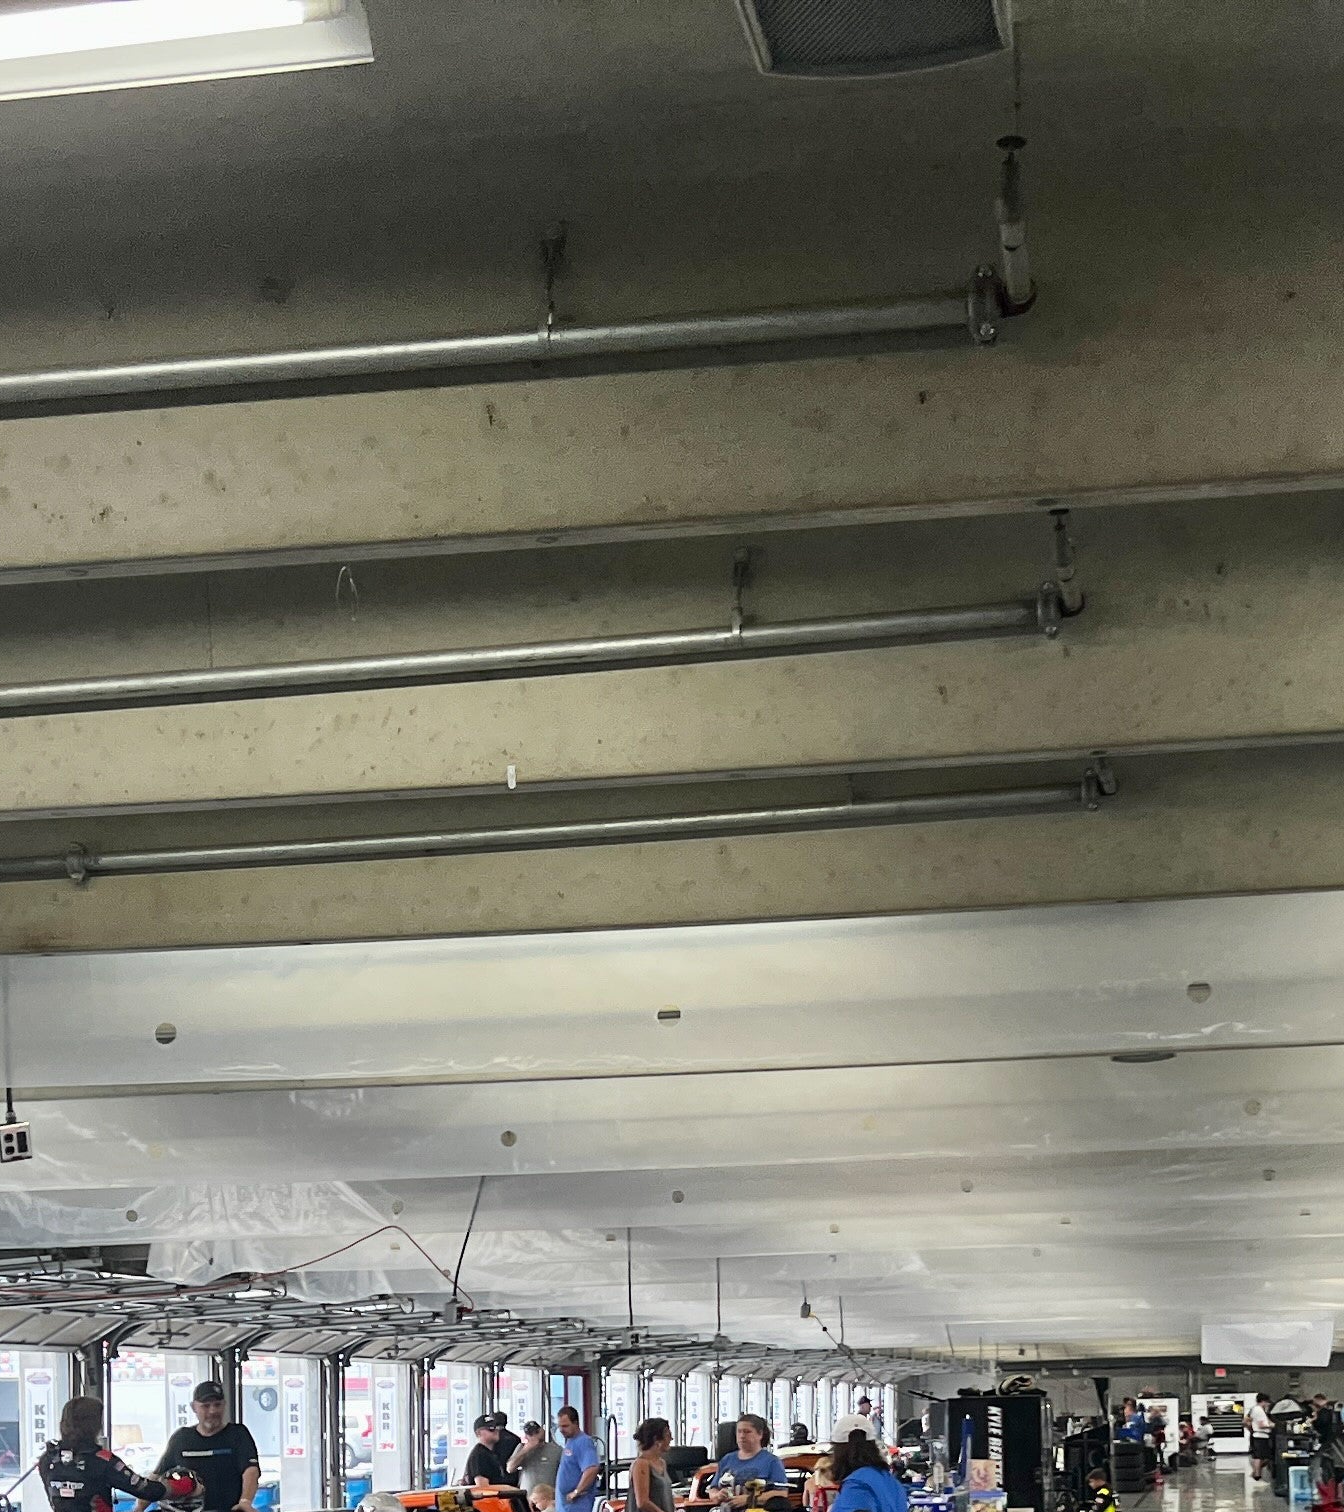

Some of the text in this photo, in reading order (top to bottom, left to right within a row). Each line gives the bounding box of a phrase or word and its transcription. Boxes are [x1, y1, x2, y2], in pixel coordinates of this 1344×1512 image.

[35, 1404, 46, 1443] KBR
[290, 1403, 299, 1433] KBR
[987, 1405, 1003, 1435] KYLE
